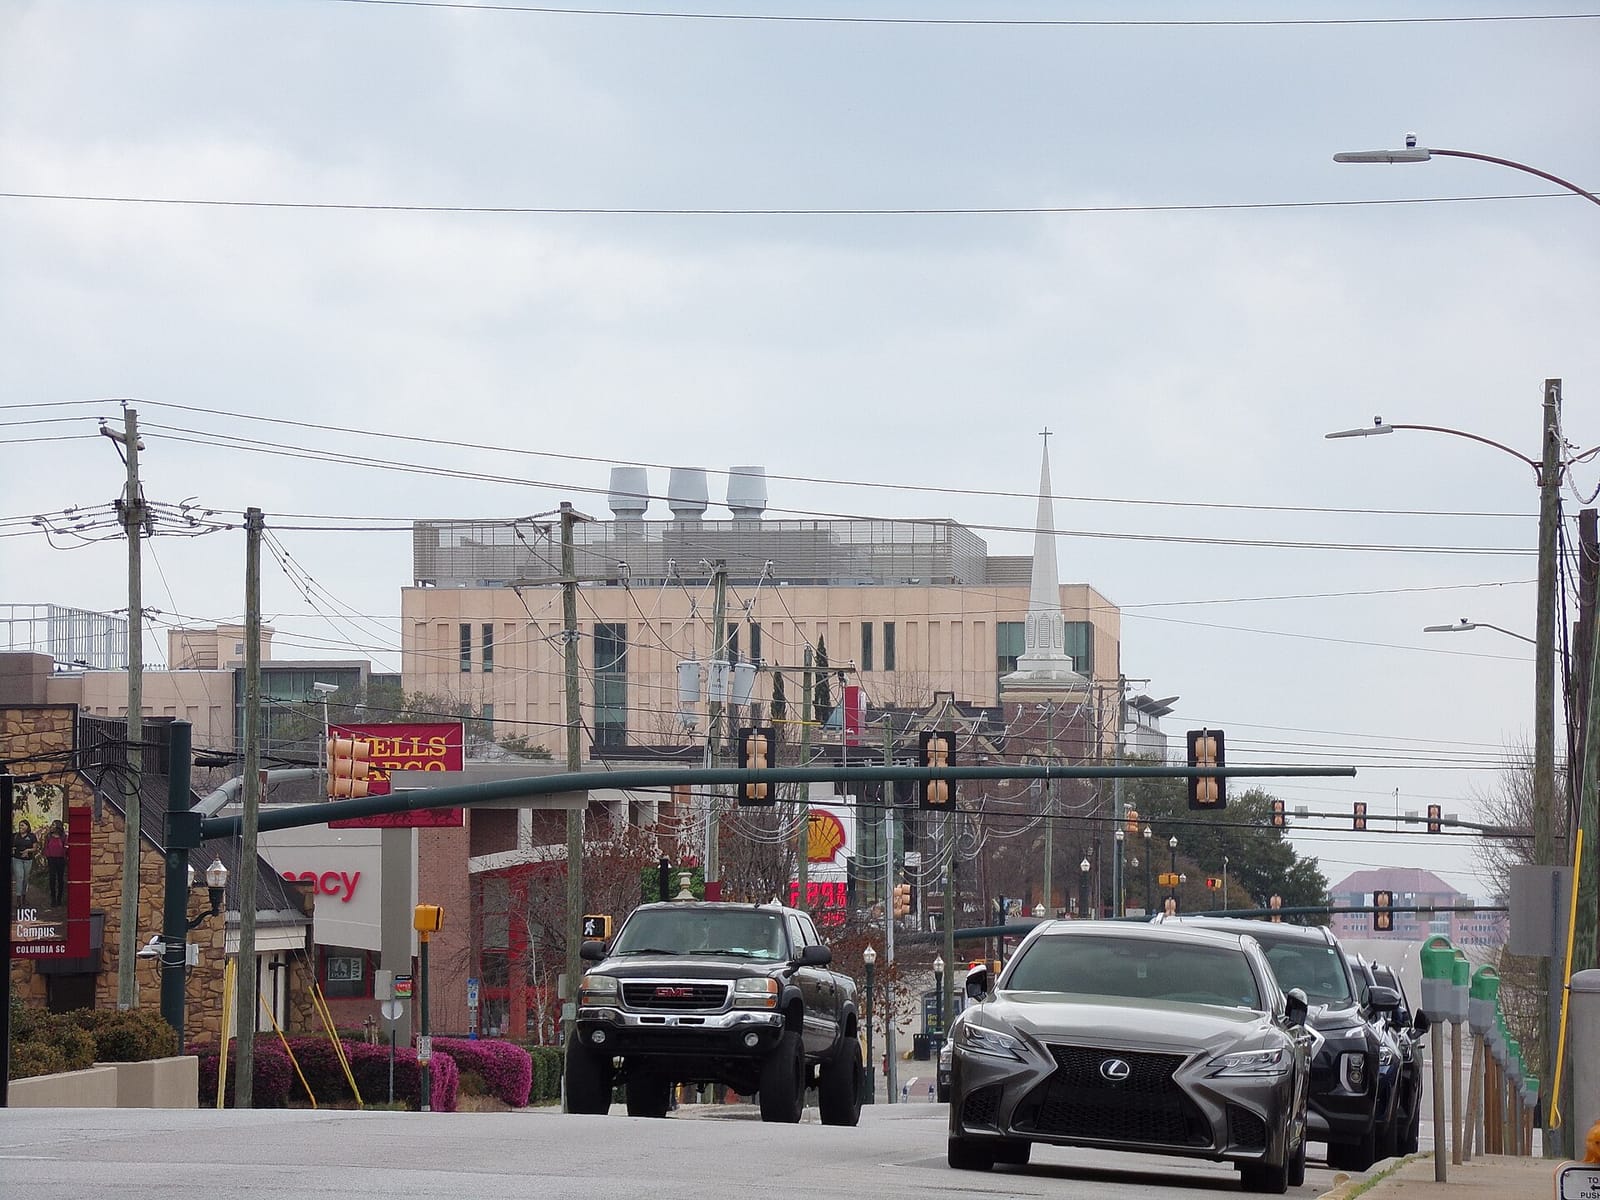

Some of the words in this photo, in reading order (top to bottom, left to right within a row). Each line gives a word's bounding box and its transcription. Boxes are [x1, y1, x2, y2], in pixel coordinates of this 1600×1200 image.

[17, 909, 37, 921] USC
[16, 925, 55, 940] Campus
[16, 945, 54, 953] COLUMBIA
[55, 945, 66, 953] SC
[656, 986, 693, 997] GMC
